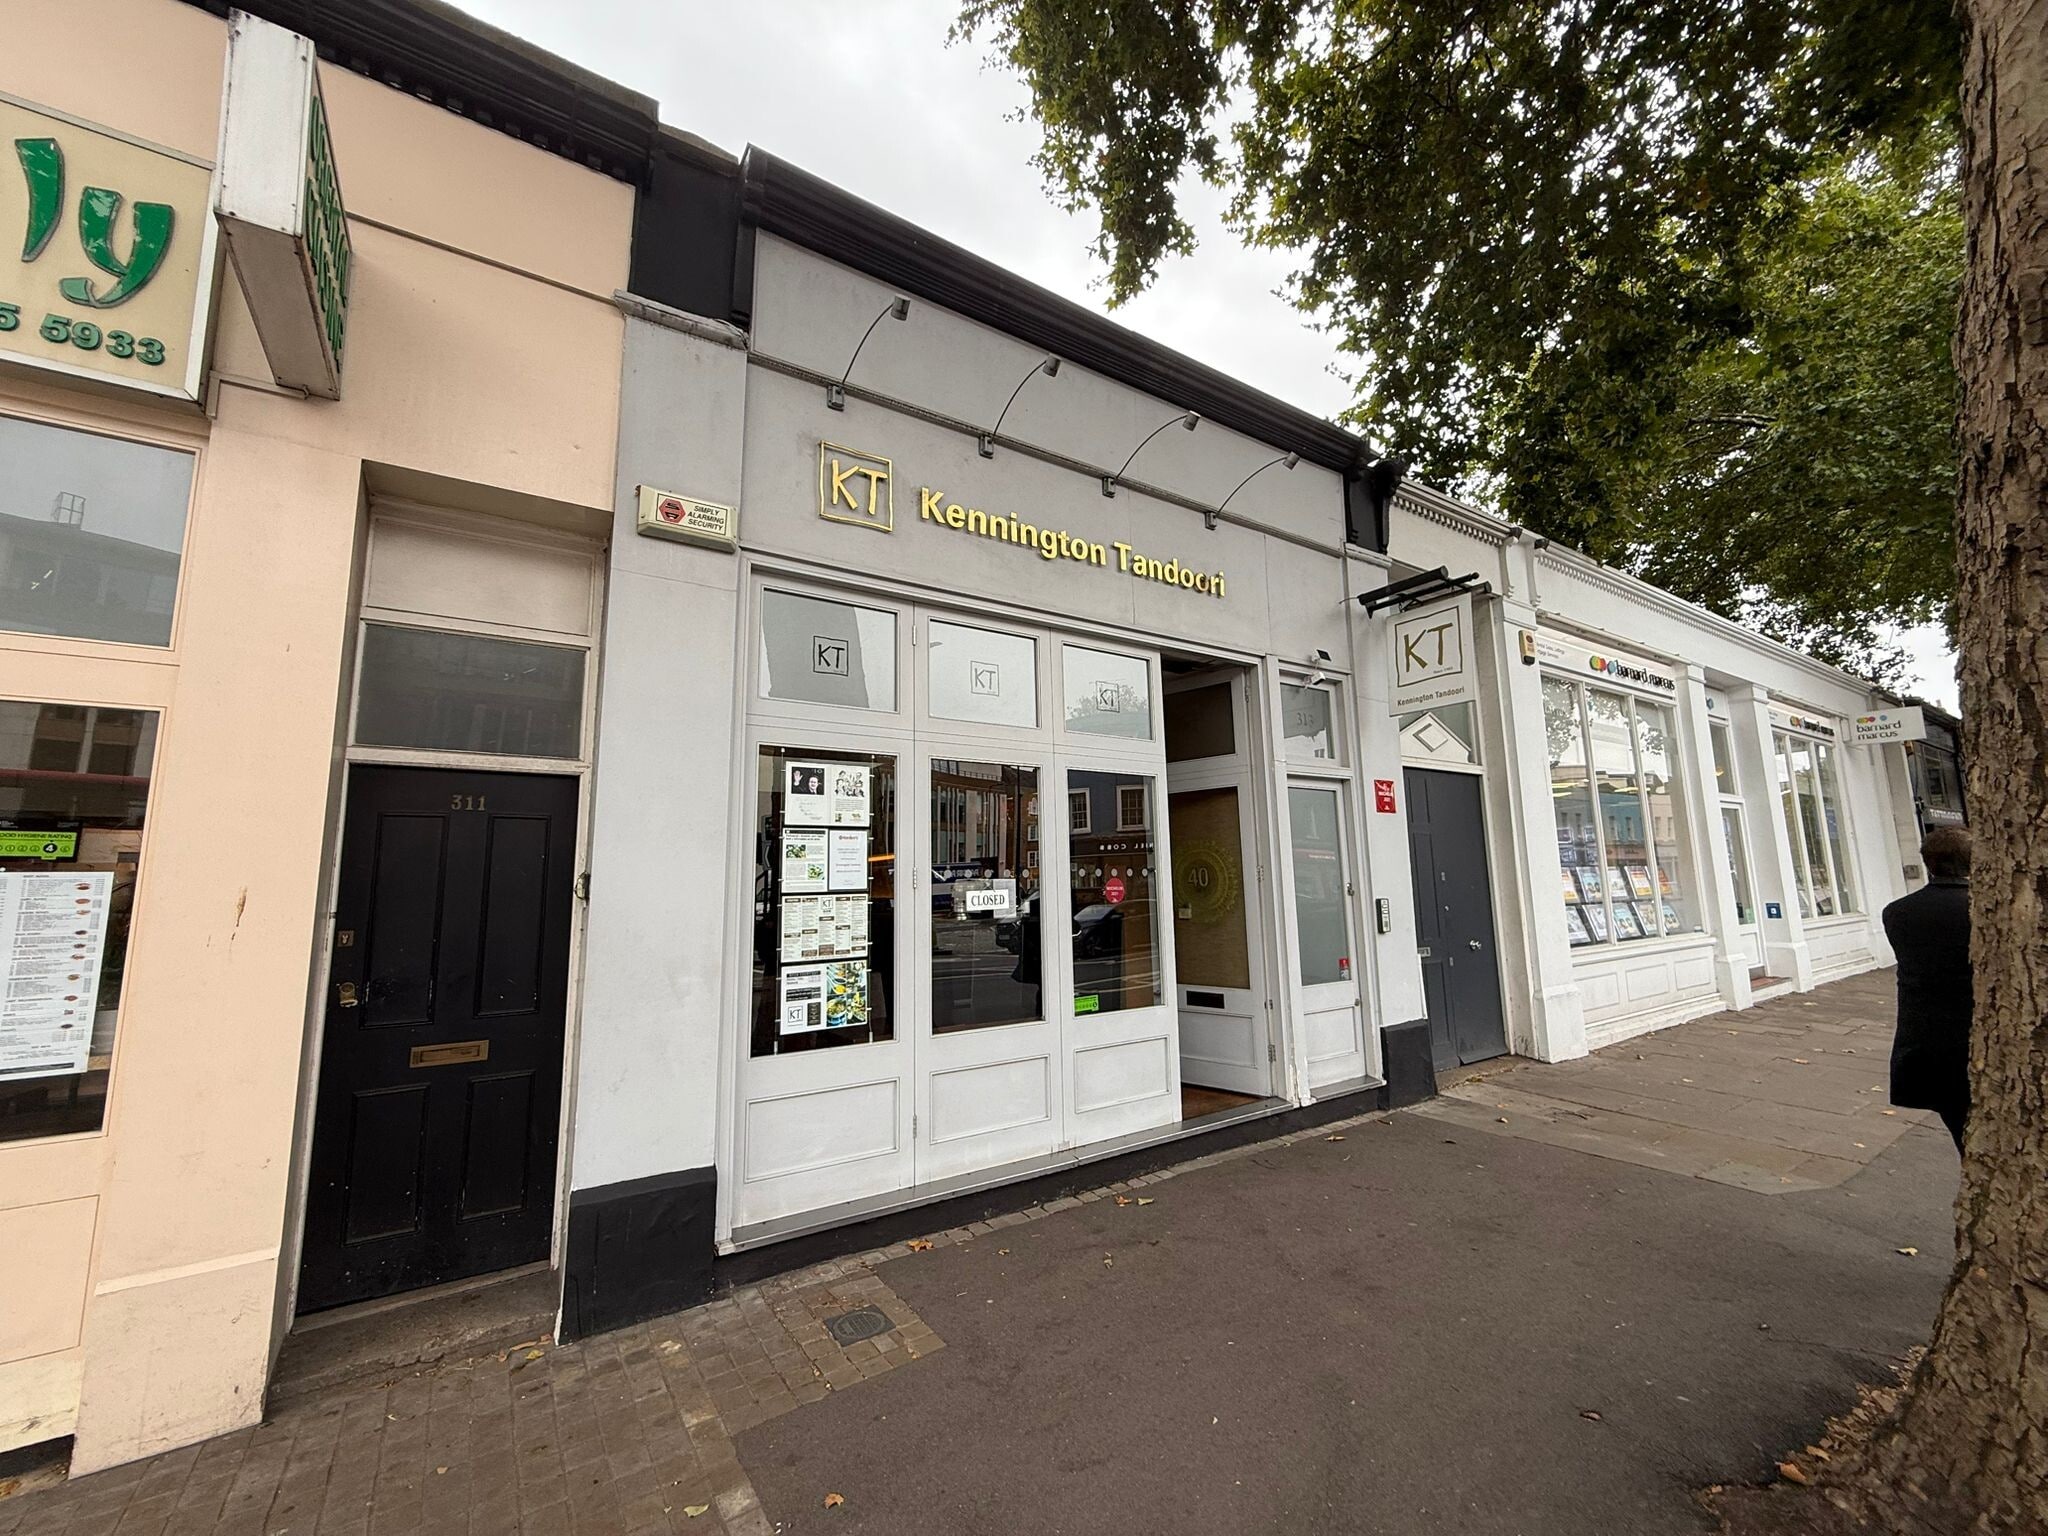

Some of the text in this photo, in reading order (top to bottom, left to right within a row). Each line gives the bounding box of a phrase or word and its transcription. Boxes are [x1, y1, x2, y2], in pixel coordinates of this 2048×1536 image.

[39, 312, 166, 366] 5933
[831, 458, 888, 516] KT
[687, 511, 725, 525] ALARMING
[694, 505, 720, 516] SIMPLY
[688, 518, 724, 532] SECURITY
[919, 486, 1226, 598] Kennington Tandoori
[818, 643, 845, 670] KT
[1404, 622, 1453, 673] KT
[974, 666, 996, 691] KT
[1098, 686, 1118, 707] KT
[1397, 686, 1465, 707] Kennington Tandoori
[1856, 720, 1902, 733] barnard
[1858, 730, 1899, 741] marcus
[451, 794, 486, 811] 311
[1188, 867, 1209, 887] 40
[970, 894, 1005, 907] CLOSED
